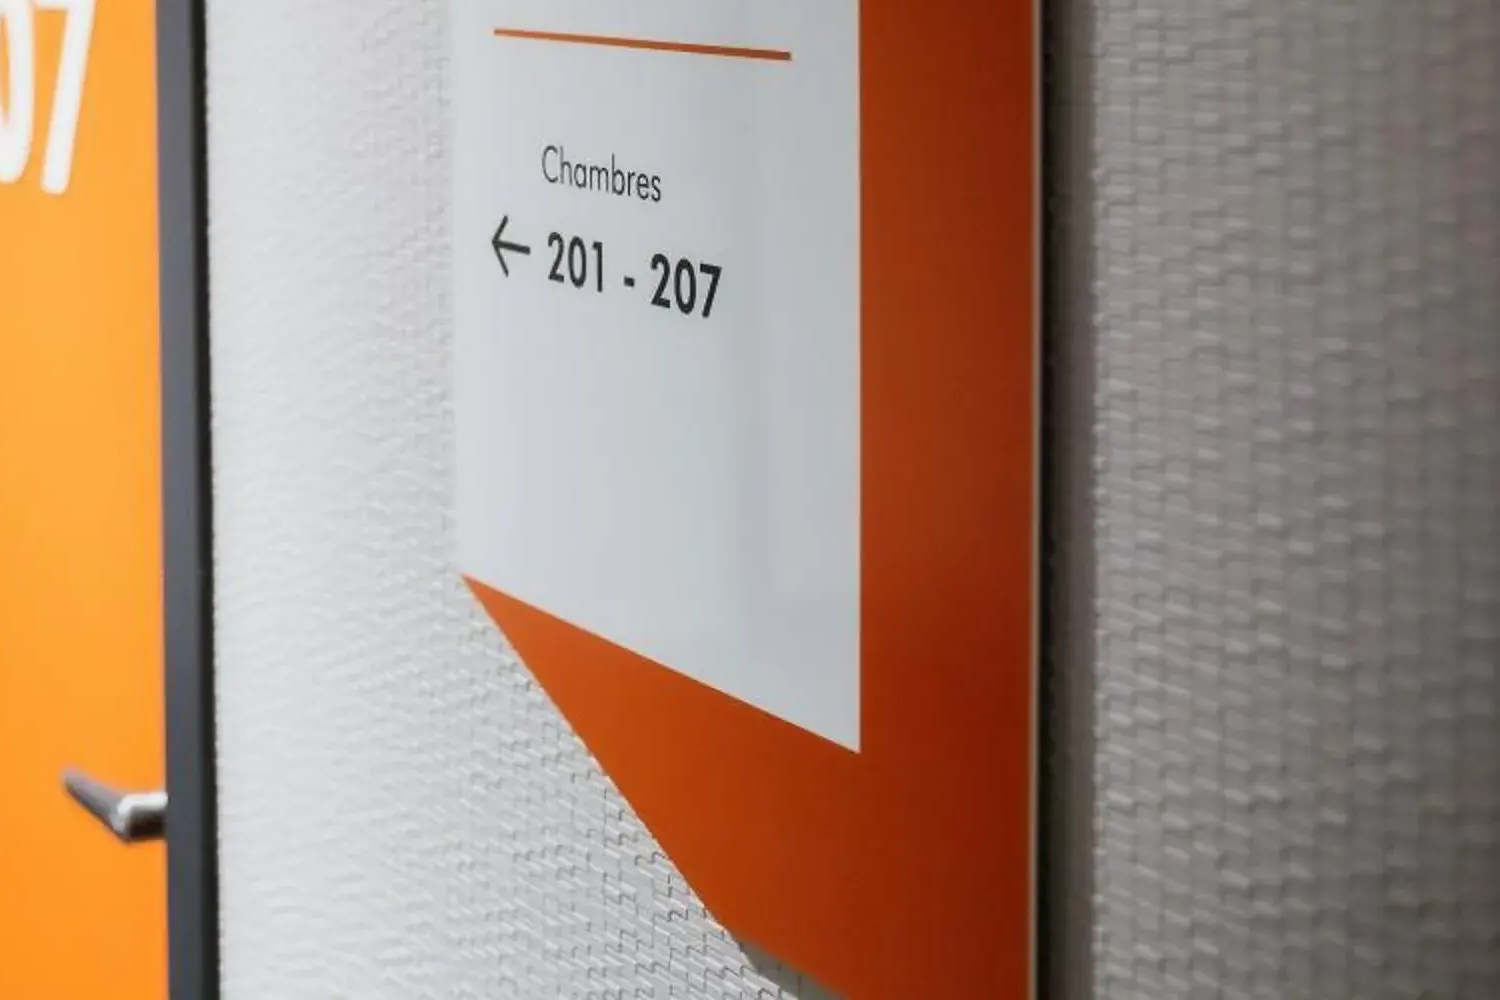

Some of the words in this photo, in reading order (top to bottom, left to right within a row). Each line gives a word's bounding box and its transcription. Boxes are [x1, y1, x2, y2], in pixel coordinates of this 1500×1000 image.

[541, 144, 663, 203] Chambres
[546, 231, 604, 293] 201
[623, 275, 636, 288] -
[649, 252, 723, 319] 207
